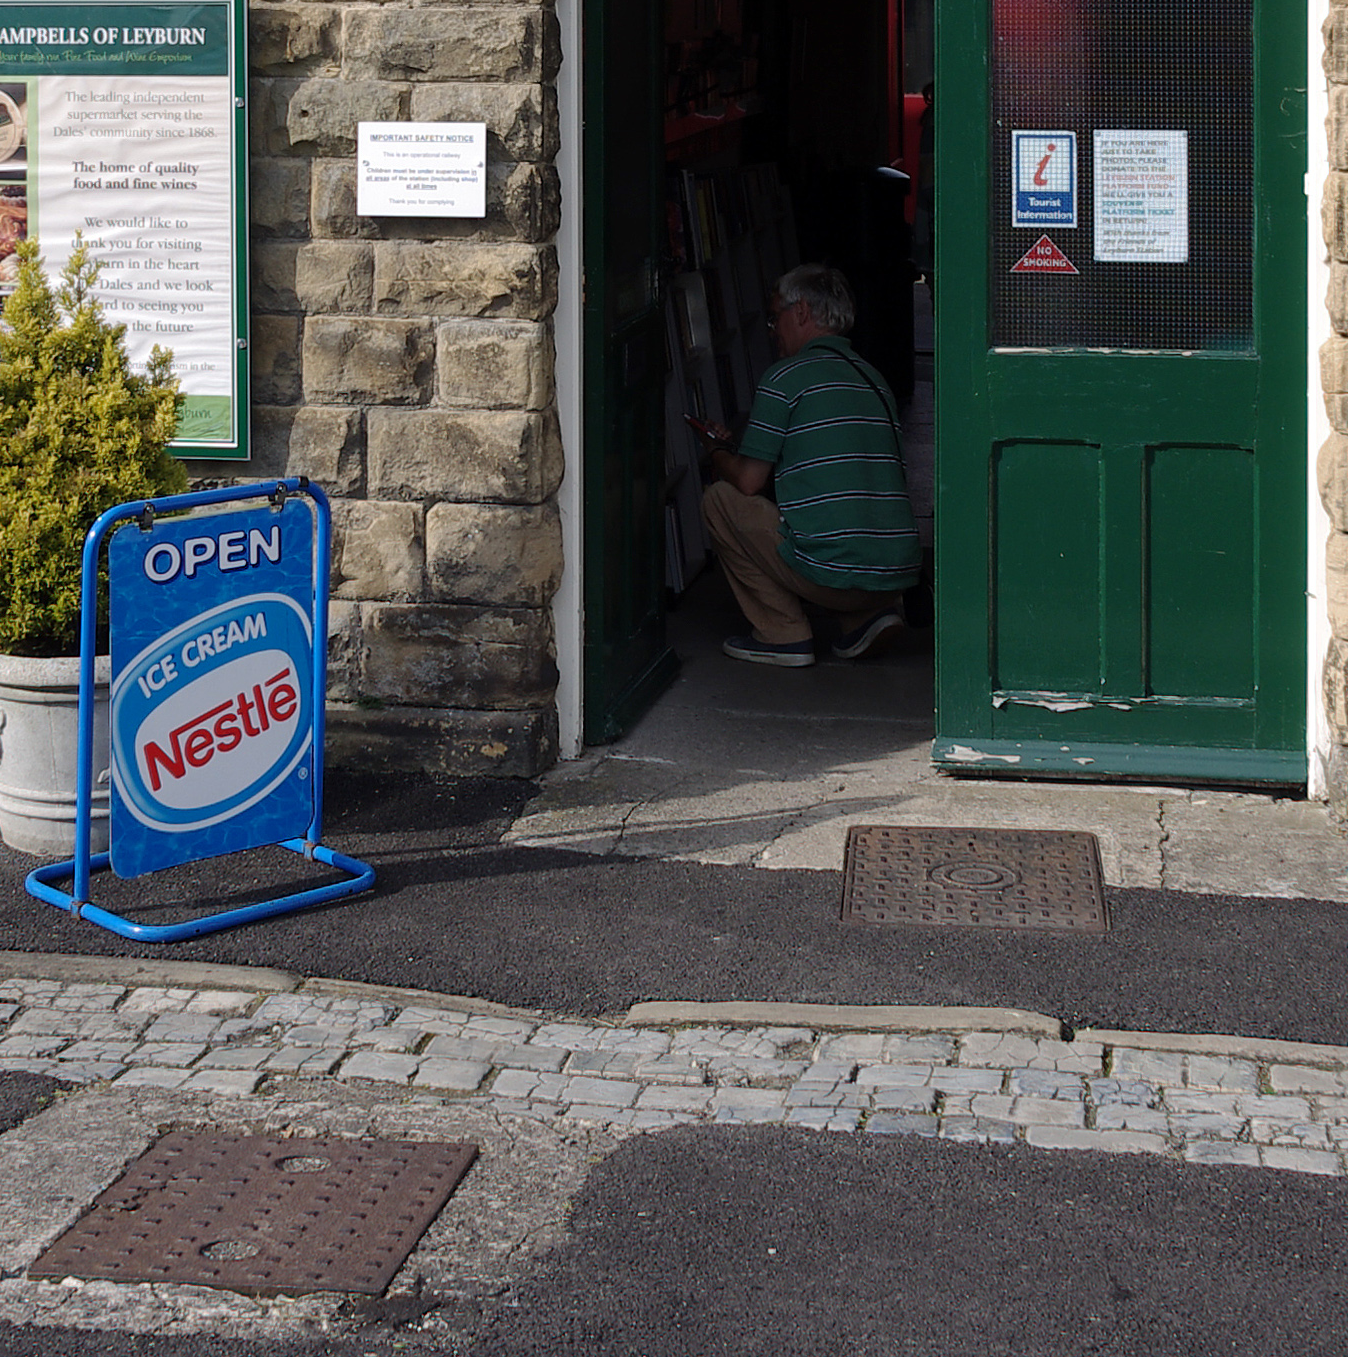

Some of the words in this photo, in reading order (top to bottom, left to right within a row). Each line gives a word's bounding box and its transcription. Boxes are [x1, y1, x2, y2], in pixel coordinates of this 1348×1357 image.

[93, 28, 118, 45] OF
[122, 27, 206, 45] LEYBURN
[84, 50, 106, 61] Food
[65, 91, 87, 103] The
[89, 91, 130, 104] leading
[133, 91, 205, 105] independent
[67, 110, 138, 121] supermarket
[141, 110, 181, 121] serving
[184, 109, 203, 121] the
[53, 126, 87, 138] Dales'
[90, 126, 152, 141] community
[156, 126, 186, 138] since
[188, 127, 218, 138] 1868.
[370, 134, 413, 142] IMPORTANT
[415, 134, 443, 142] SAFETY
[72, 161, 96, 173] The
[99, 161, 135, 173] home
[138, 161, 153, 173] of
[155, 161, 199, 176] quality
[73, 178, 99, 190] food
[102, 178, 129, 190] and
[133, 178, 158, 190] fine
[160, 178, 198, 190] wines
[1028, 197, 1061, 207] Tourist
[1017, 210, 1072, 219] Information
[84, 217, 103, 228] We
[106, 217, 145, 229] would
[150, 217, 171, 229] like
[176, 218, 188, 229] to
[110, 239, 132, 251] you
[136, 237, 154, 249] for
[157, 238, 202, 252] visiting
[1037, 246, 1052, 255] NO
[128, 258, 140, 269] in
[144, 259, 164, 270] the
[167, 259, 200, 270] heart
[1023, 258, 1067, 267] SMOKING
[100, 279, 133, 290] Dales
[137, 279, 160, 290] and
[164, 281, 182, 290] we
[186, 280, 214, 291] look
[122, 301, 134, 310] to
[137, 301, 177, 313] seeing
[181, 302, 204, 314] you
[133, 320, 151, 332] the
[156, 321, 194, 332] future
[144, 525, 281, 583] OPEN
[137, 653, 178, 699] ICE
[181, 612, 267, 669] CREAM
[143, 667, 297, 792] Nestlé
